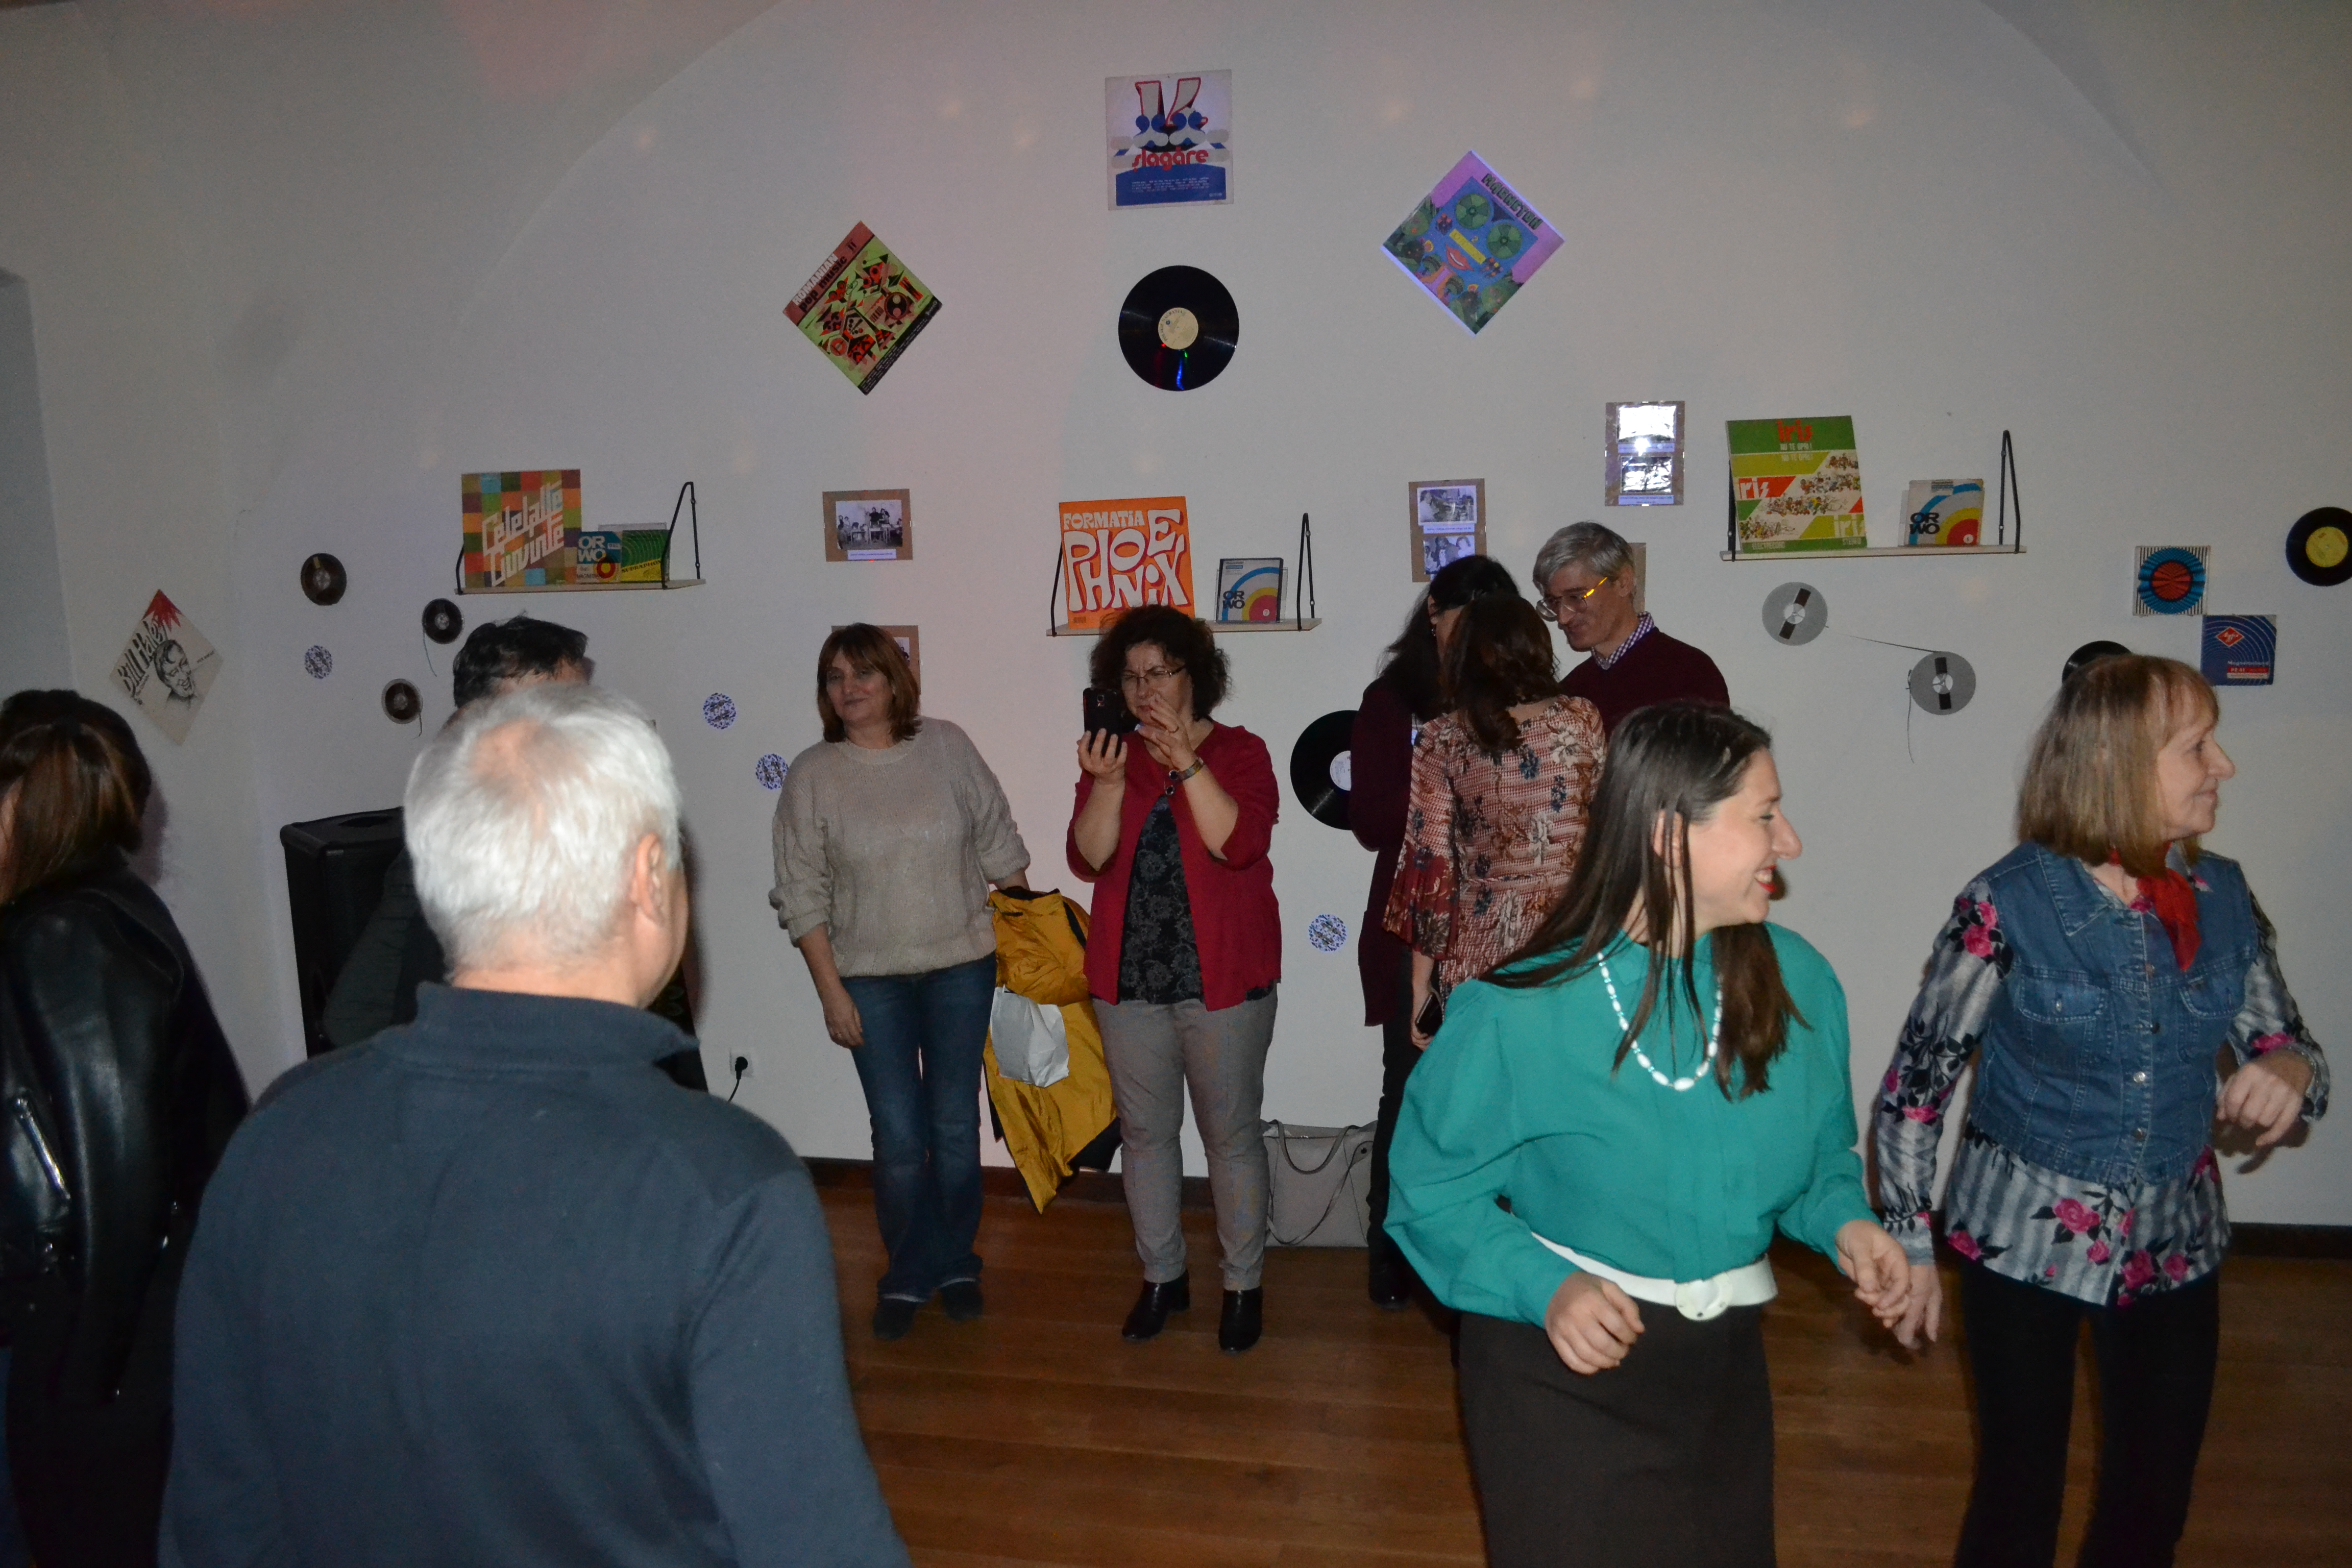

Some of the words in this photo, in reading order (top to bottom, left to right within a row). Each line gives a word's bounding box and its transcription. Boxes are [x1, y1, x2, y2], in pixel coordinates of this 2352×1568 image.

[1481, 173, 1544, 230] MAGNETON
[792, 252, 839, 305] ROMANIAN
[799, 287, 818, 312] pop
[820, 255, 847, 289] music
[1776, 419, 1813, 442] iris
